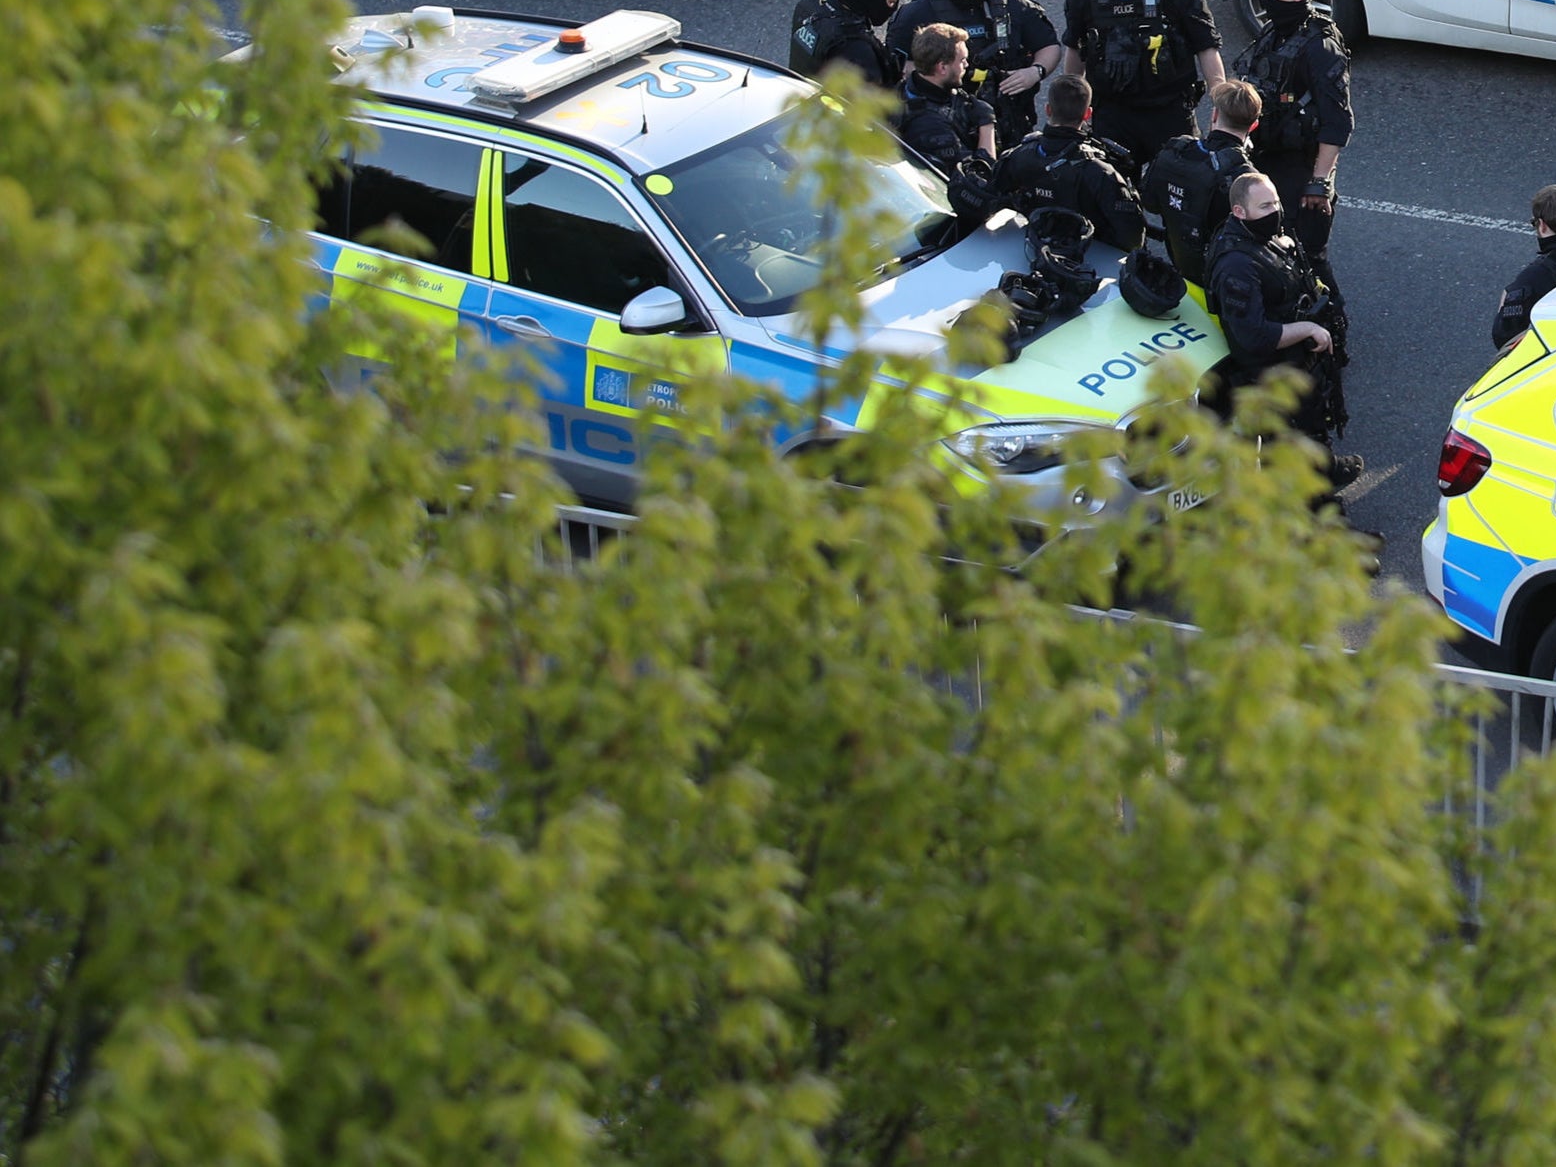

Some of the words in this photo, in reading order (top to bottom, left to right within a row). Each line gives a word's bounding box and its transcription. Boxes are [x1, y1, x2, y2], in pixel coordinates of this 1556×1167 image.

[1113, 5, 1135, 15] POLICE
[795, 27, 816, 49] POLICE
[616, 60, 732, 99] 02
[1035, 187, 1054, 199] POLICE
[1168, 183, 1185, 197] POLICE
[1077, 322, 1209, 397] POLICE
[646, 395, 690, 415] POLIC
